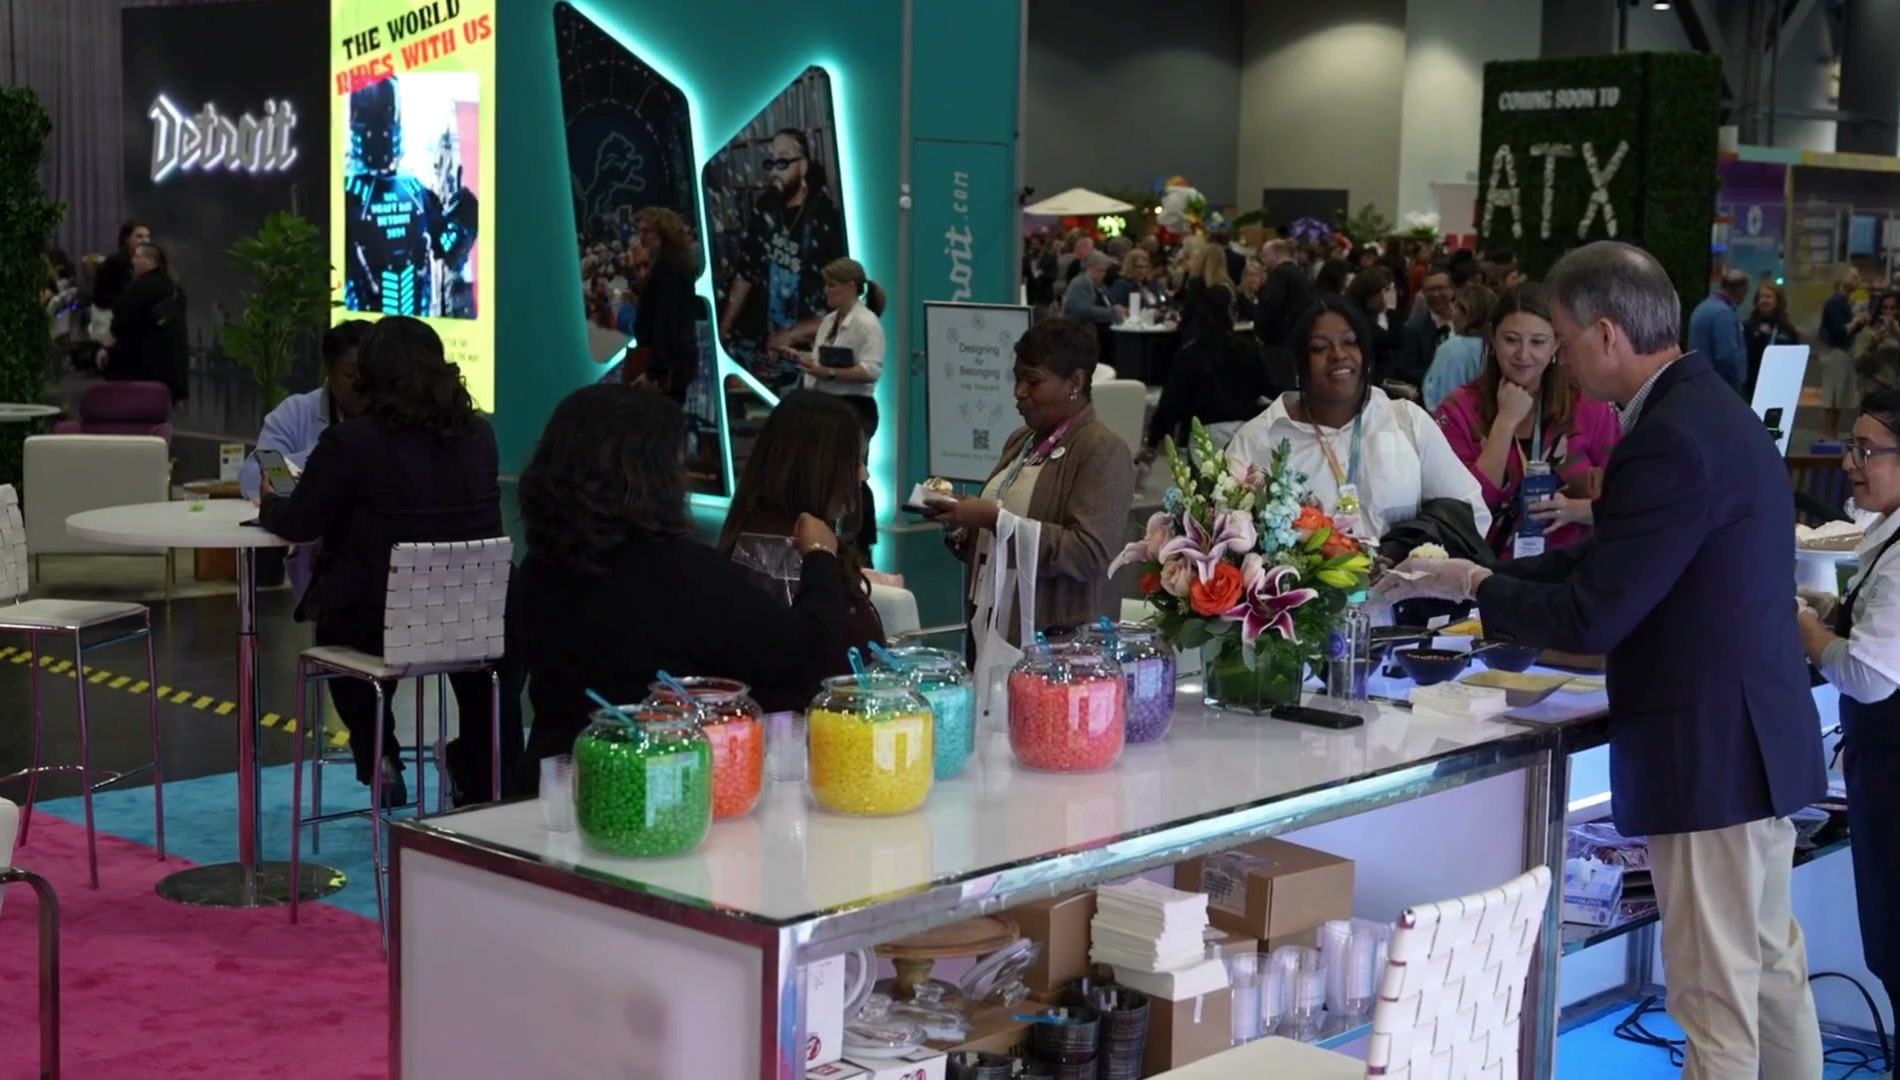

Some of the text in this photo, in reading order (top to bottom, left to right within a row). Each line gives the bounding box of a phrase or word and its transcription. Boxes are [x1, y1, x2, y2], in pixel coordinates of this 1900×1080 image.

[342, 0, 460, 60] THE WORLD
[336, 14, 492, 96] RIDES WITH US
[1499, 86, 1620, 111] COMING SOON TO
[148, 94, 297, 182] Detroit
[1482, 139, 1629, 239] ATX
[958, 342, 1000, 357] Designing
[974, 357, 984, 366] for
[959, 365, 1000, 380] Belonging
